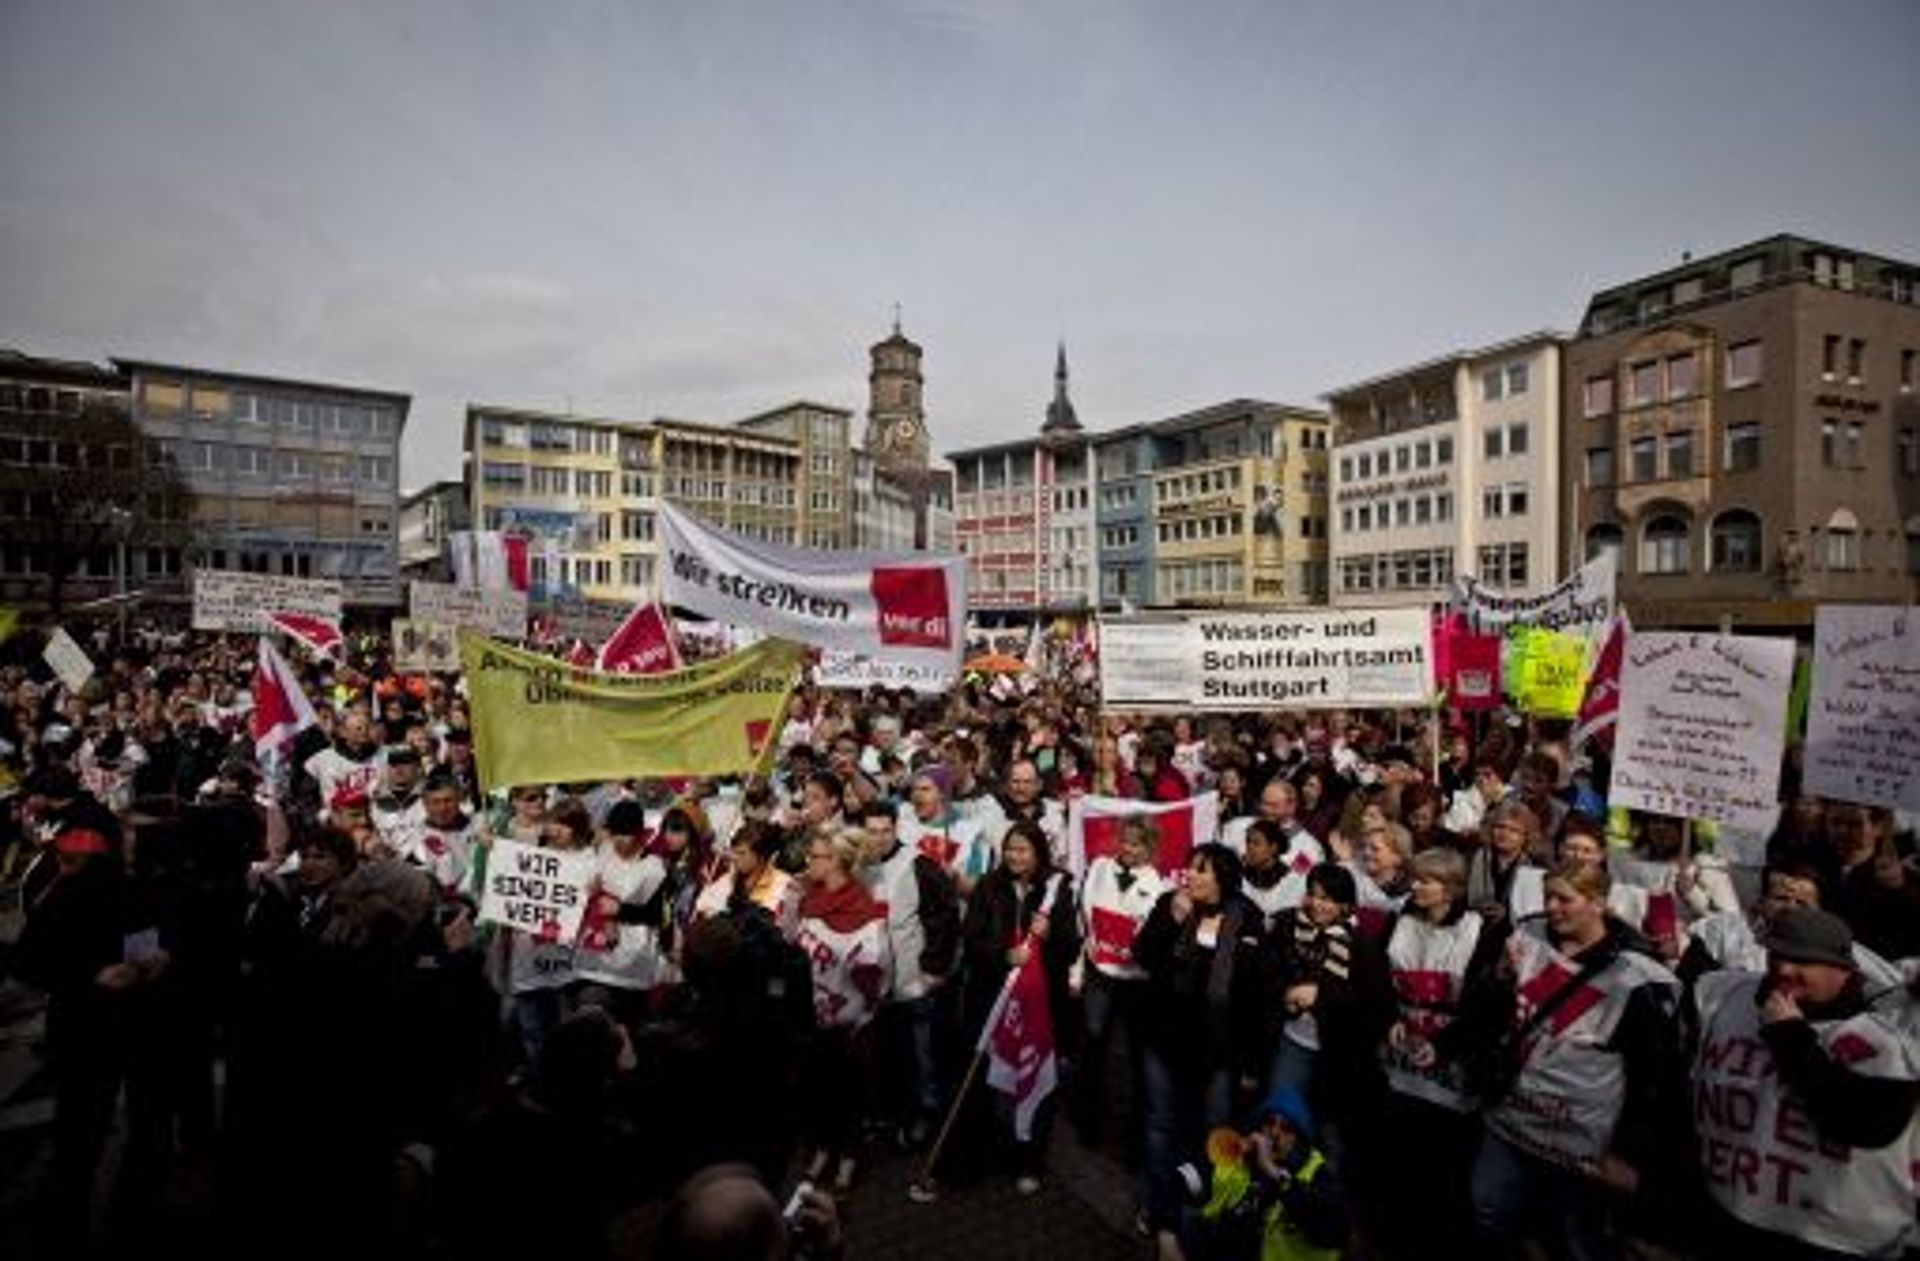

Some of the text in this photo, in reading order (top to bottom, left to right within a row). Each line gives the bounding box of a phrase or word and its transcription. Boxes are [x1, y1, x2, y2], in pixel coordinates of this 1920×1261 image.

[670, 549, 849, 621] Wir streiken
[1200, 617, 1376, 641] Wasser- und
[1203, 646, 1424, 671] Schifffahrtsamt
[1203, 676, 1329, 699] Stuttgart
[518, 852, 560, 878] WIR
[493, 875, 578, 907] SIND ES
